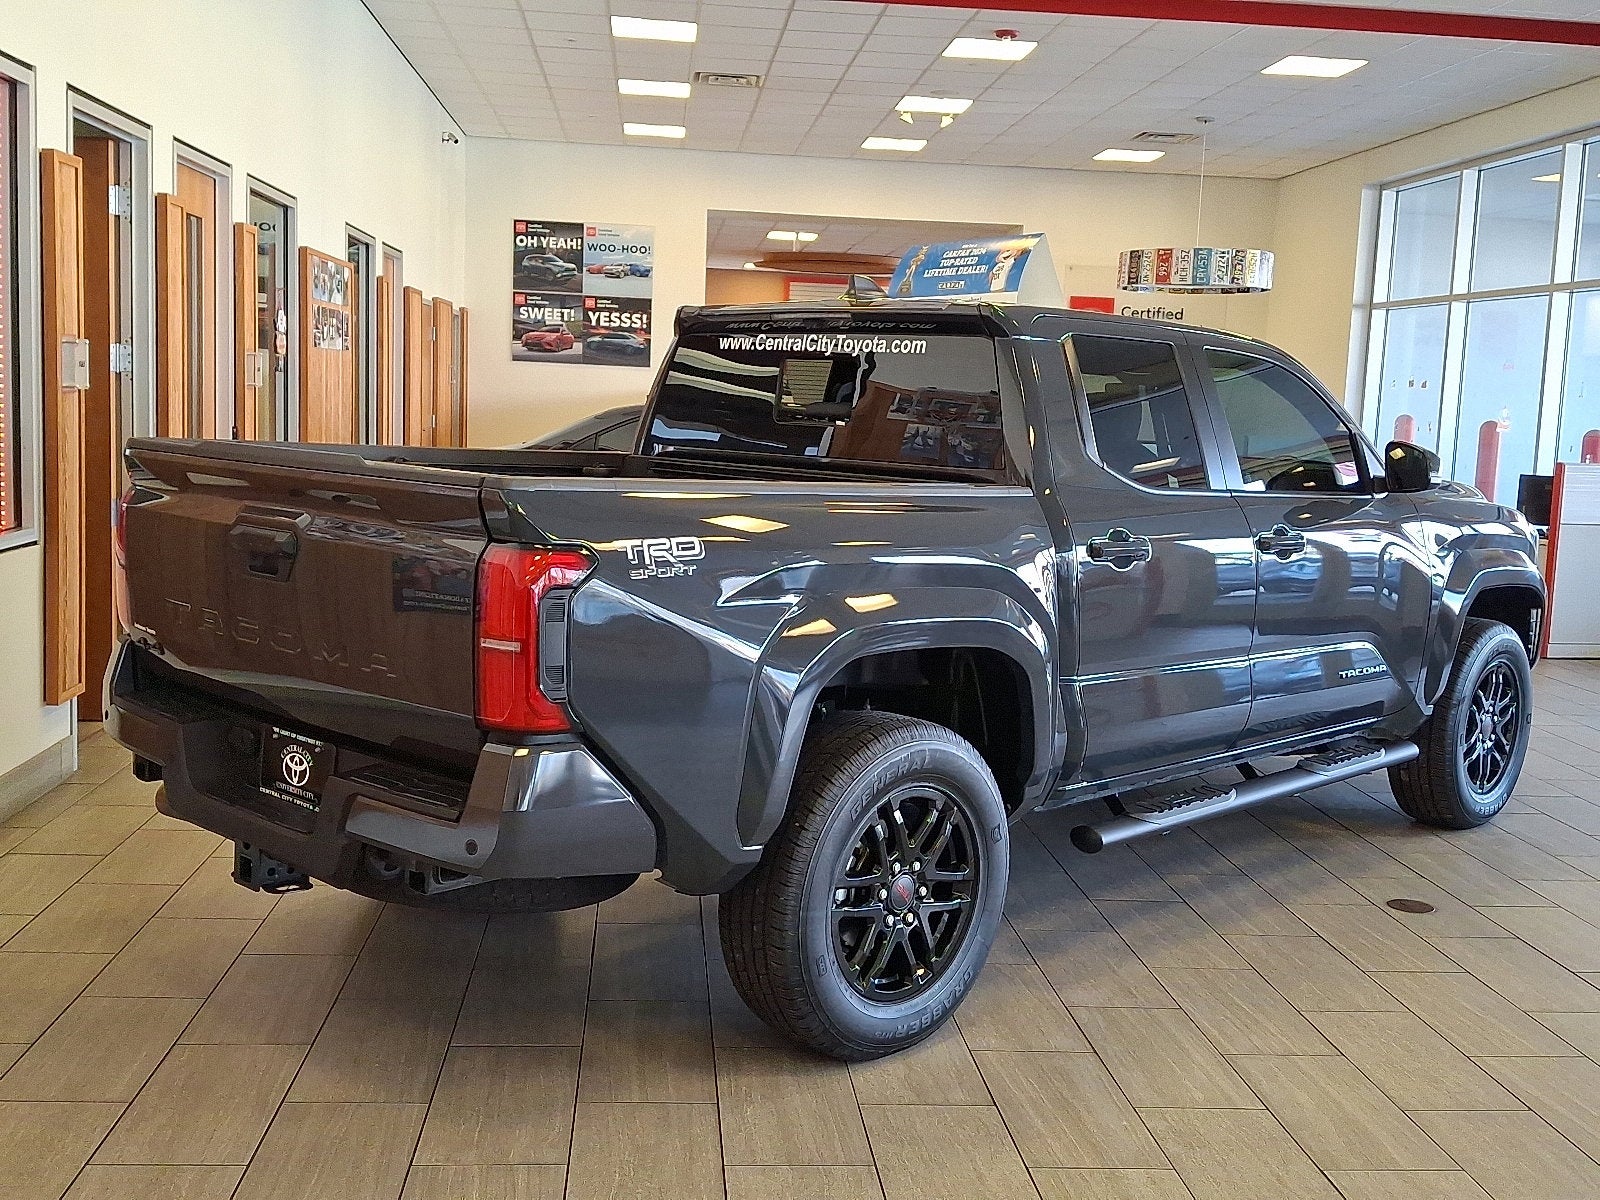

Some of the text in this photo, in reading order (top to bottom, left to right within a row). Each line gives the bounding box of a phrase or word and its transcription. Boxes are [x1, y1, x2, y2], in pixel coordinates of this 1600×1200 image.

[515, 235, 582, 250] OH YEAH!
[586, 242, 652, 255] WOO-HOO!
[939, 256, 979, 267] TOP-RATED
[923, 267, 958, 278] LIFETIME
[957, 265, 988, 275] DEALER!
[519, 306, 575, 321] SWEET!
[587, 310, 648, 329] YESSS!
[1121, 305, 1184, 320] Certified
[718, 333, 928, 357] www.CentralCityToyota.com
[617, 536, 706, 567] TRD
[628, 564, 697, 580] SPORT
[164, 596, 397, 678] TACOMA
[1338, 664, 1387, 679] TACOMA
[259, 786, 281, 799] CENTRAL
[281, 794, 293, 802] CITY
